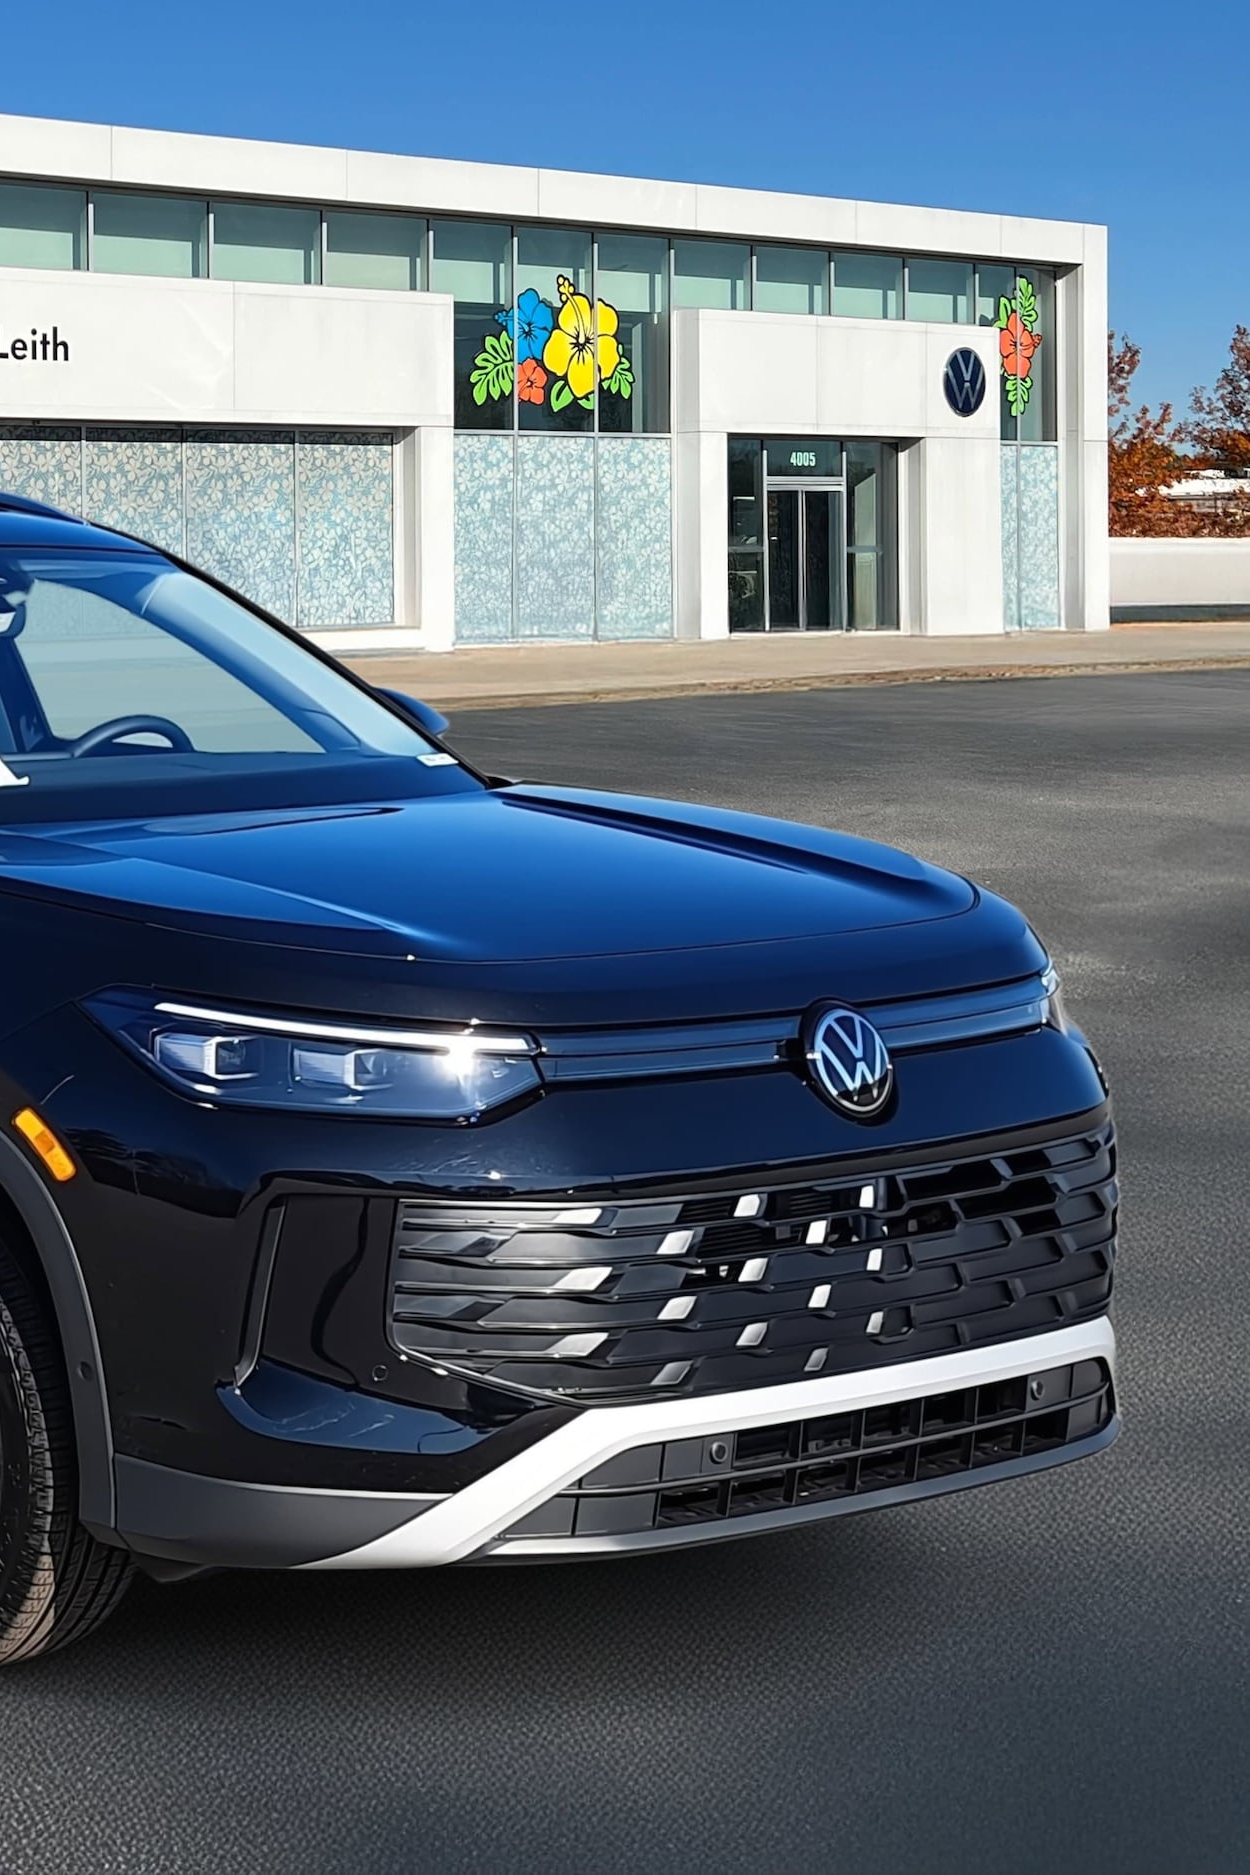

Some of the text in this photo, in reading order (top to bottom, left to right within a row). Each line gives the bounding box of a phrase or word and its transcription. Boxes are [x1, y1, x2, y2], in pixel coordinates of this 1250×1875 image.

[945, 349, 985, 413] VW
[790, 452, 816, 467] 4005
[820, 1015, 885, 1104] VW
